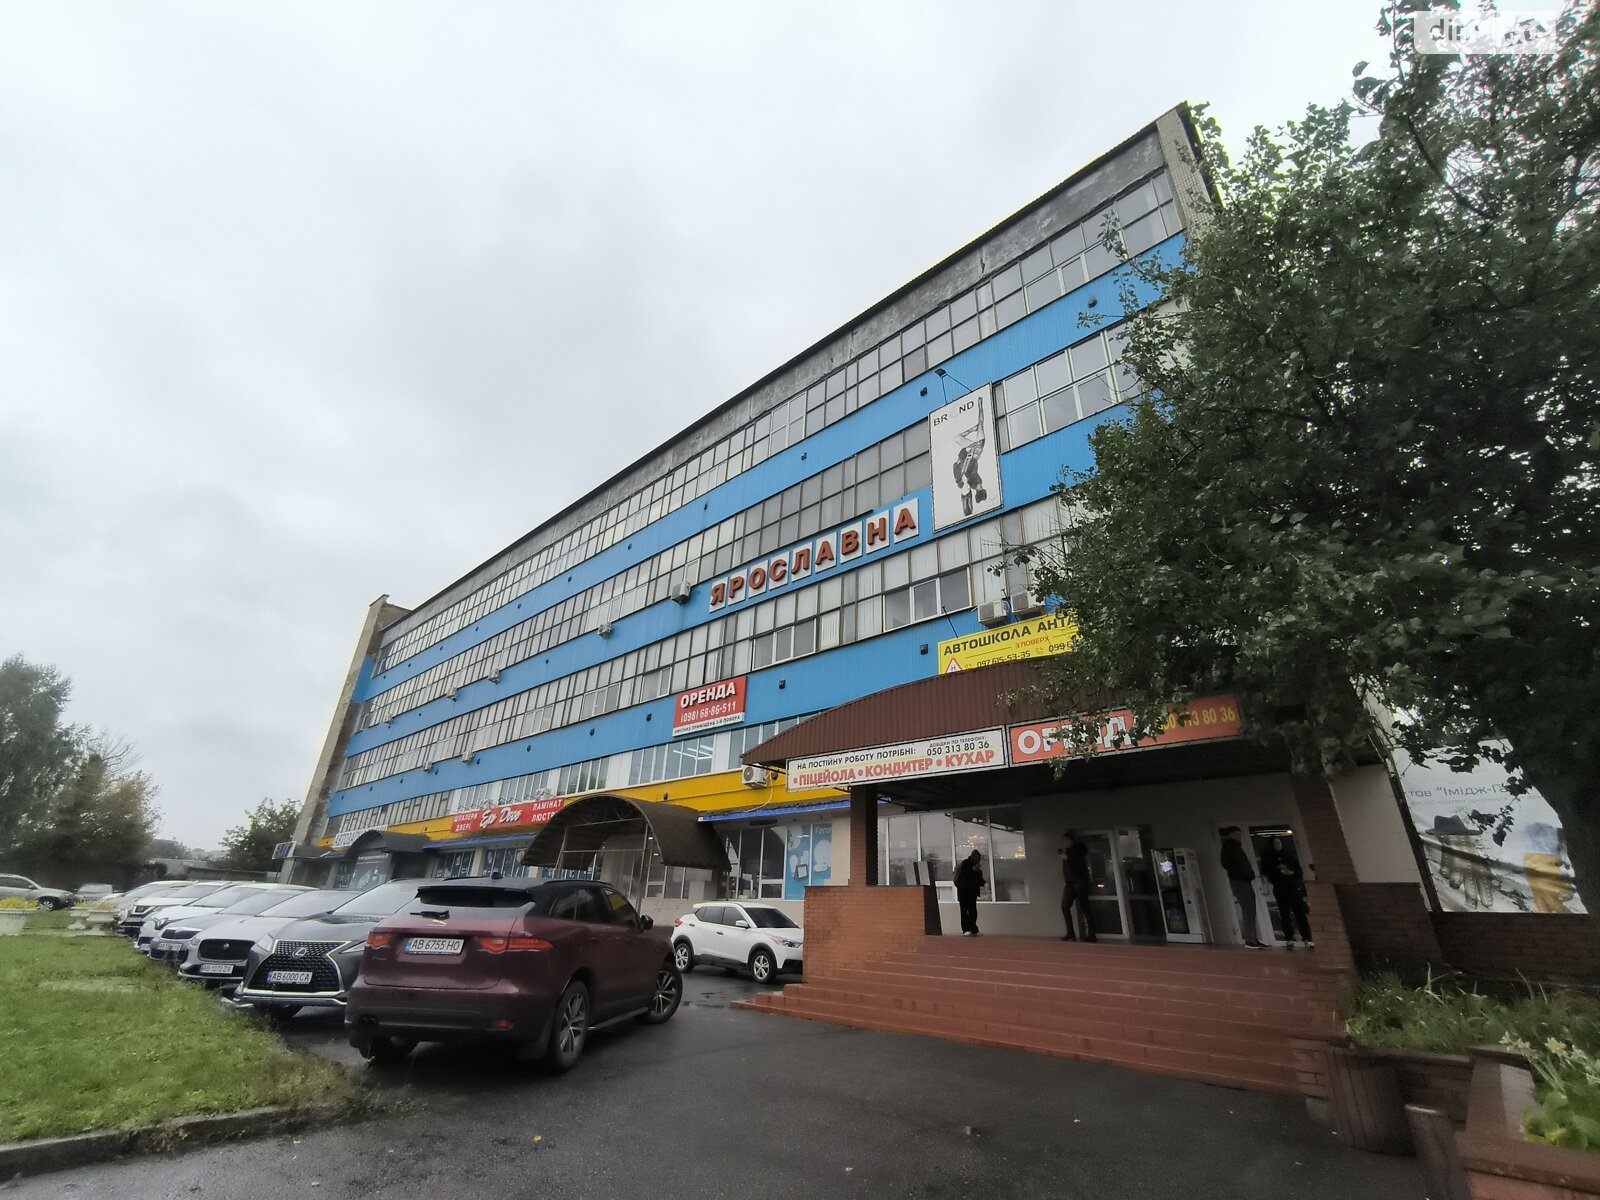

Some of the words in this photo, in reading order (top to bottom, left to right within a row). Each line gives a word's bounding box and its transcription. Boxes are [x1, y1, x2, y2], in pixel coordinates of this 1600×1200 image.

[710, 507, 916, 606] ЯРОСЛАВНА
[943, 625, 1031, 656] АВТОШКОЛА
[680, 681, 736, 708] ОРЕНДА
[680, 710, 699, 724] (098)
[926, 746, 942, 756] 050
[945, 744, 961, 754] 313
[964, 742, 975, 751] 80
[978, 740, 990, 749] 36
[797, 762, 807, 770] НА
[808, 756, 843, 768] ПОСТІЙНУ
[844, 753, 874, 763] РОБОТУ
[876, 747, 916, 759] ПОТРІБНІ:
[799, 768, 856, 786] ПІЦЕЙОЛА
[865, 758, 933, 778] КОНДИТЕР
[945, 749, 995, 768] КУХАР
[532, 799, 563, 811] ЛАМІНАТ
[411, 939, 424, 950] AB
[425, 939, 445, 950] 6755
[282, 972, 299, 982] 6000
